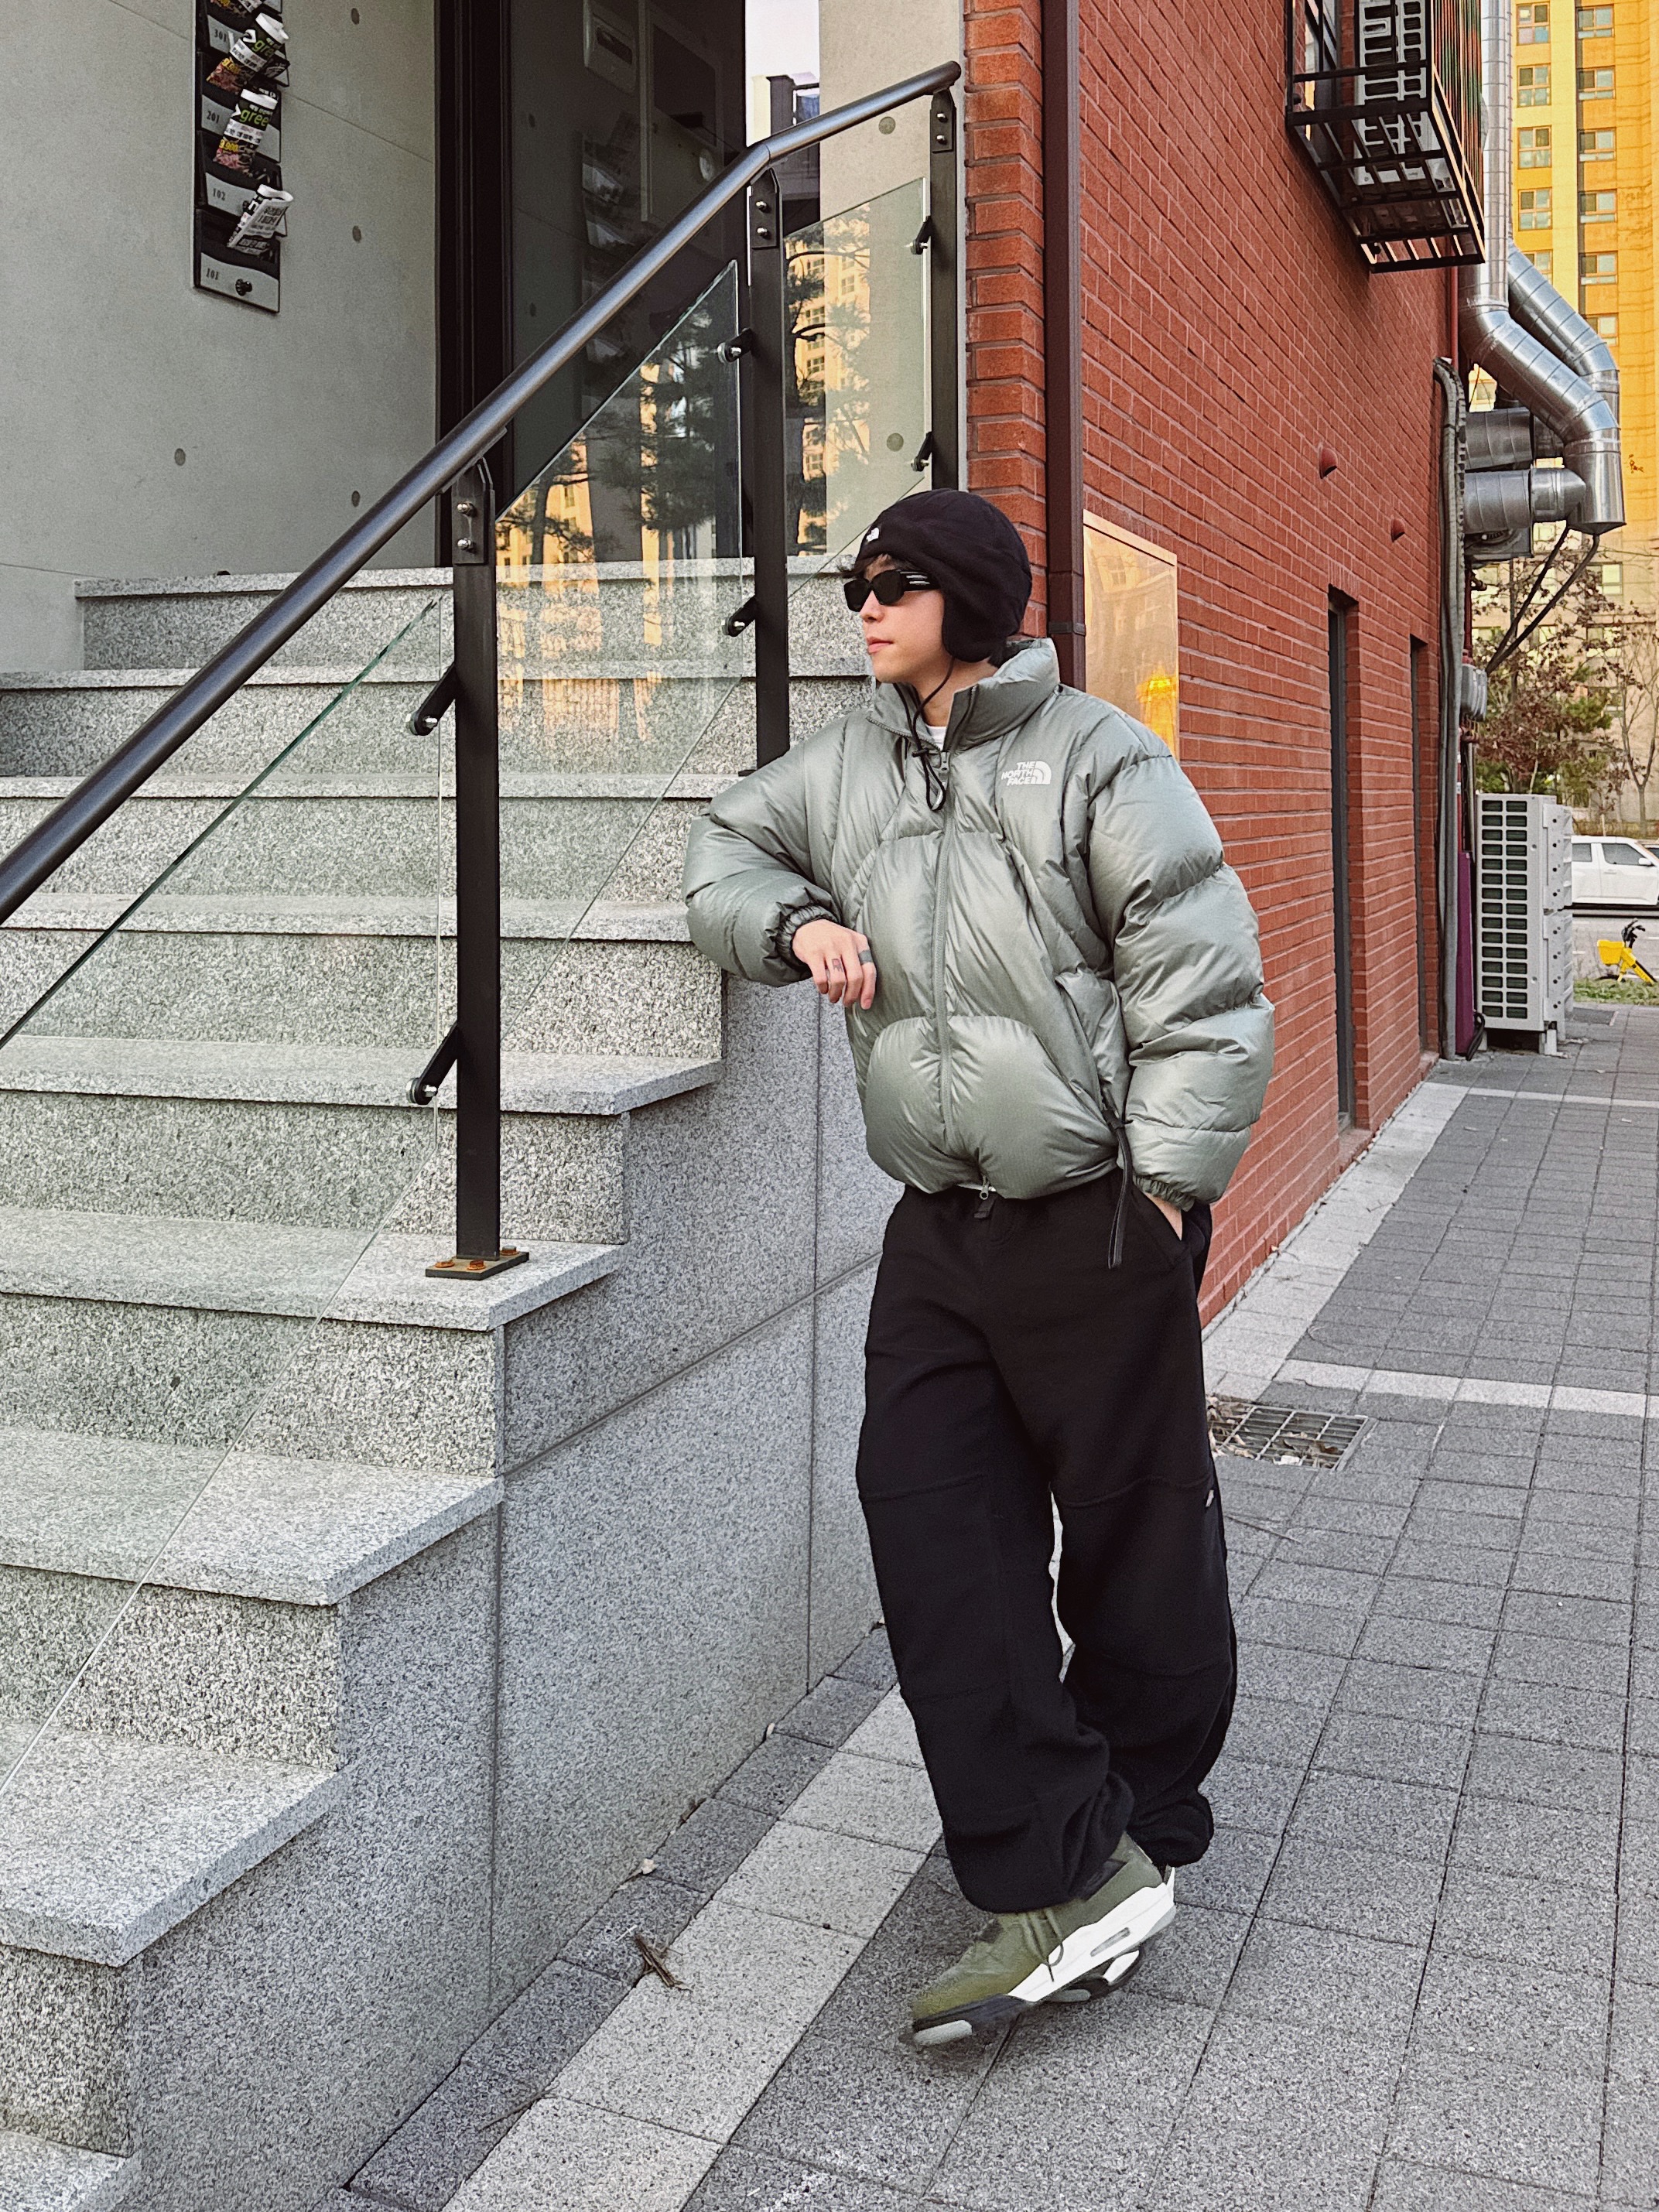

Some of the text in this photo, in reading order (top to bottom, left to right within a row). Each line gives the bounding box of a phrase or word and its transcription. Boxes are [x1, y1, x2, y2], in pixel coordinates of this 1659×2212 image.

[214, 29, 227, 42] 301
[206, 111, 220, 124] 201
[212, 188, 226, 200] 102
[205, 268, 219, 280] 101
[1017, 761, 1035, 770] THE
[1001, 769, 1033, 780] NORTH
[1007, 777, 1031, 786] FACE
